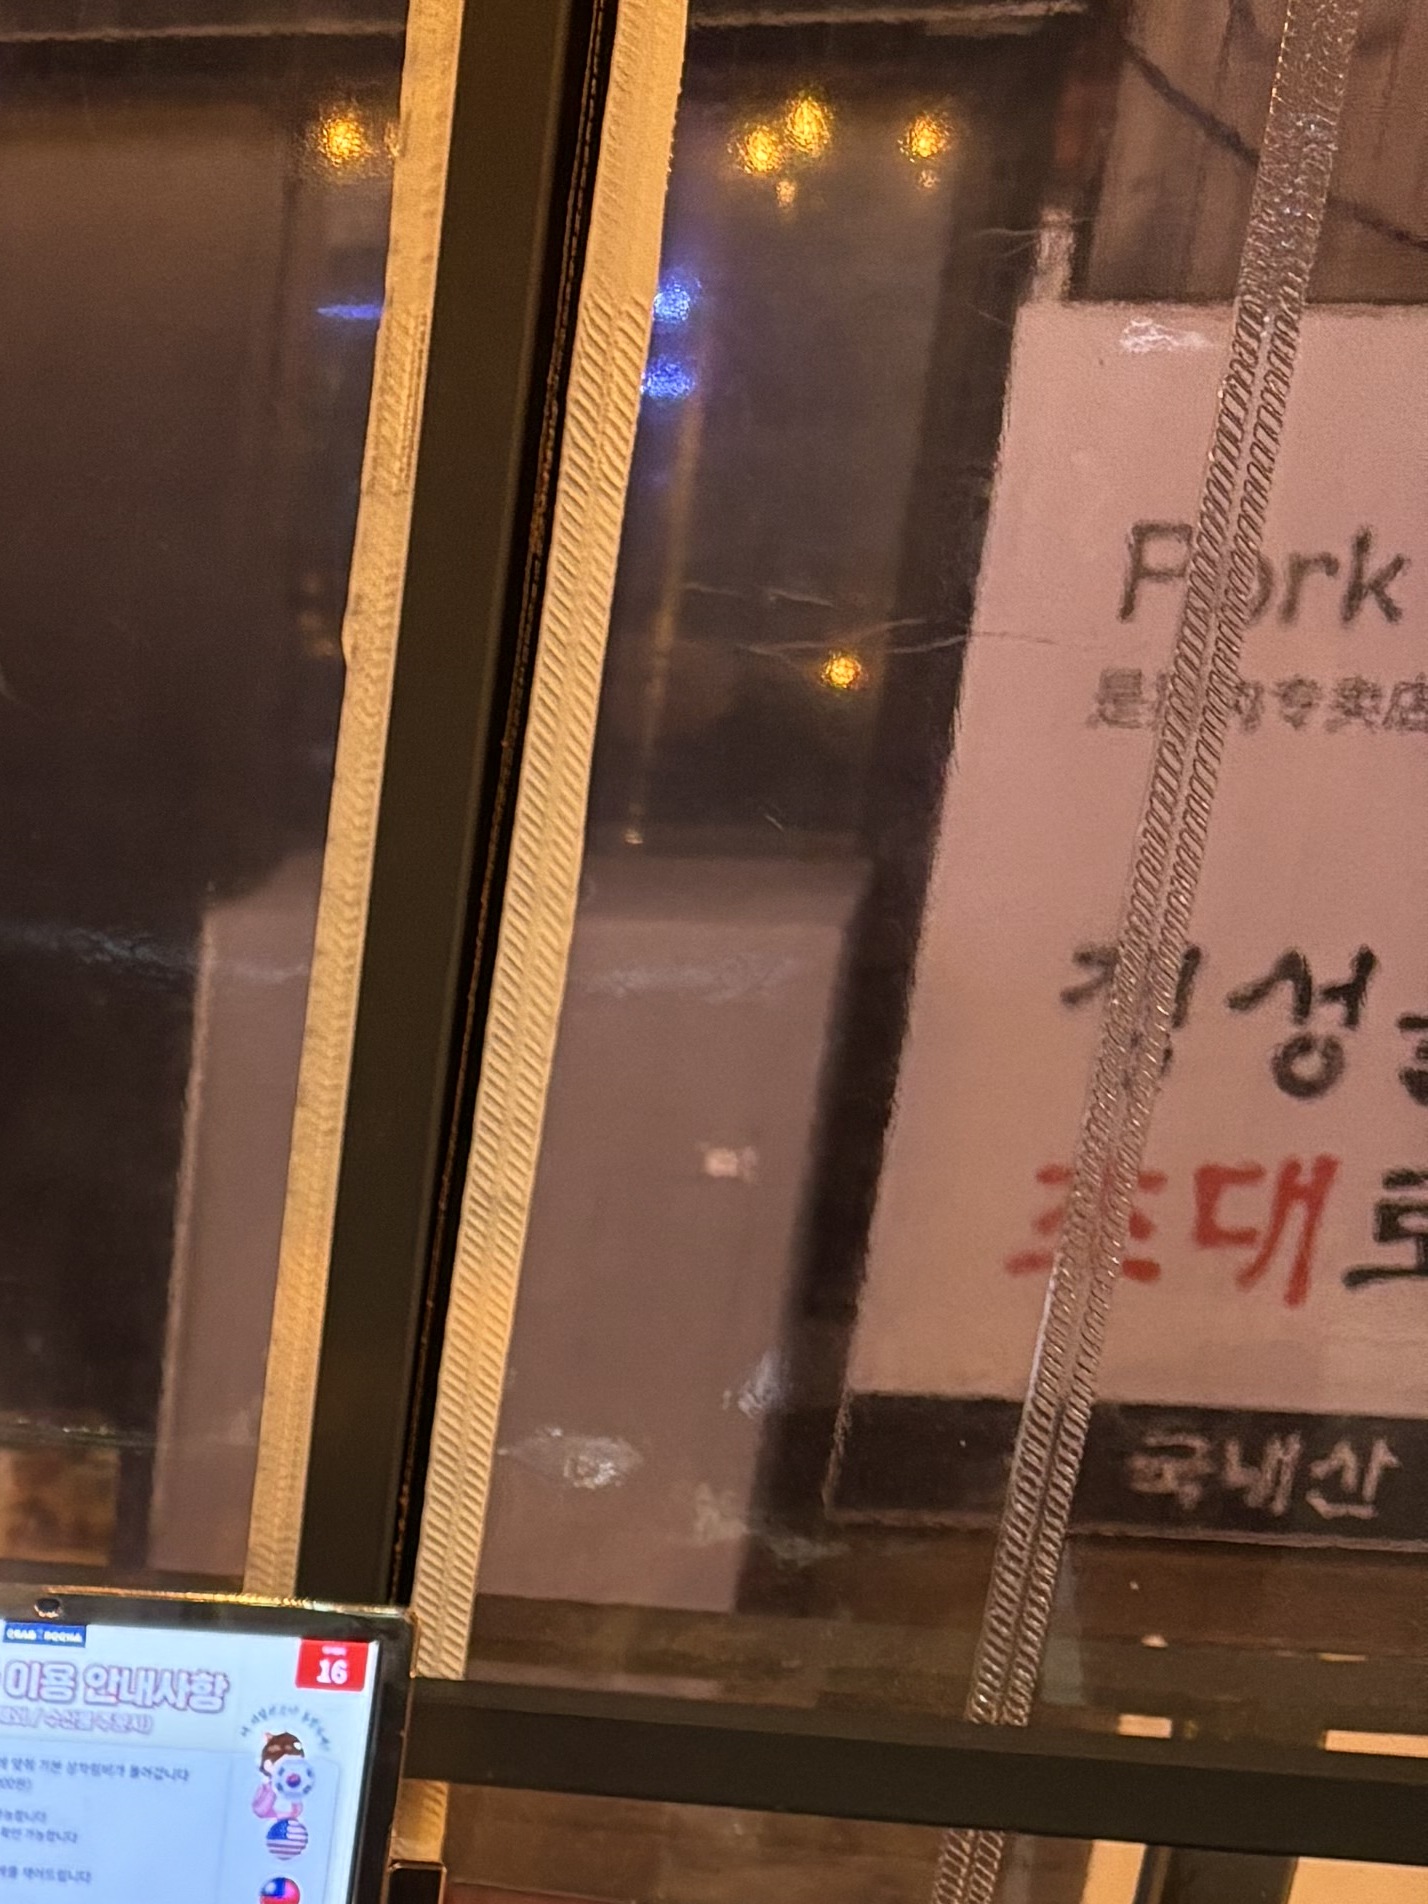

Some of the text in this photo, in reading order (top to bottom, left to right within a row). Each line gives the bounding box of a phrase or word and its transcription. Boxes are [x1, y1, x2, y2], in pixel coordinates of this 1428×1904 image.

[3, 1659, 78, 1704] 이용
[83, 1664, 230, 1714] 안내사항
[316, 1658, 348, 1685] 16
